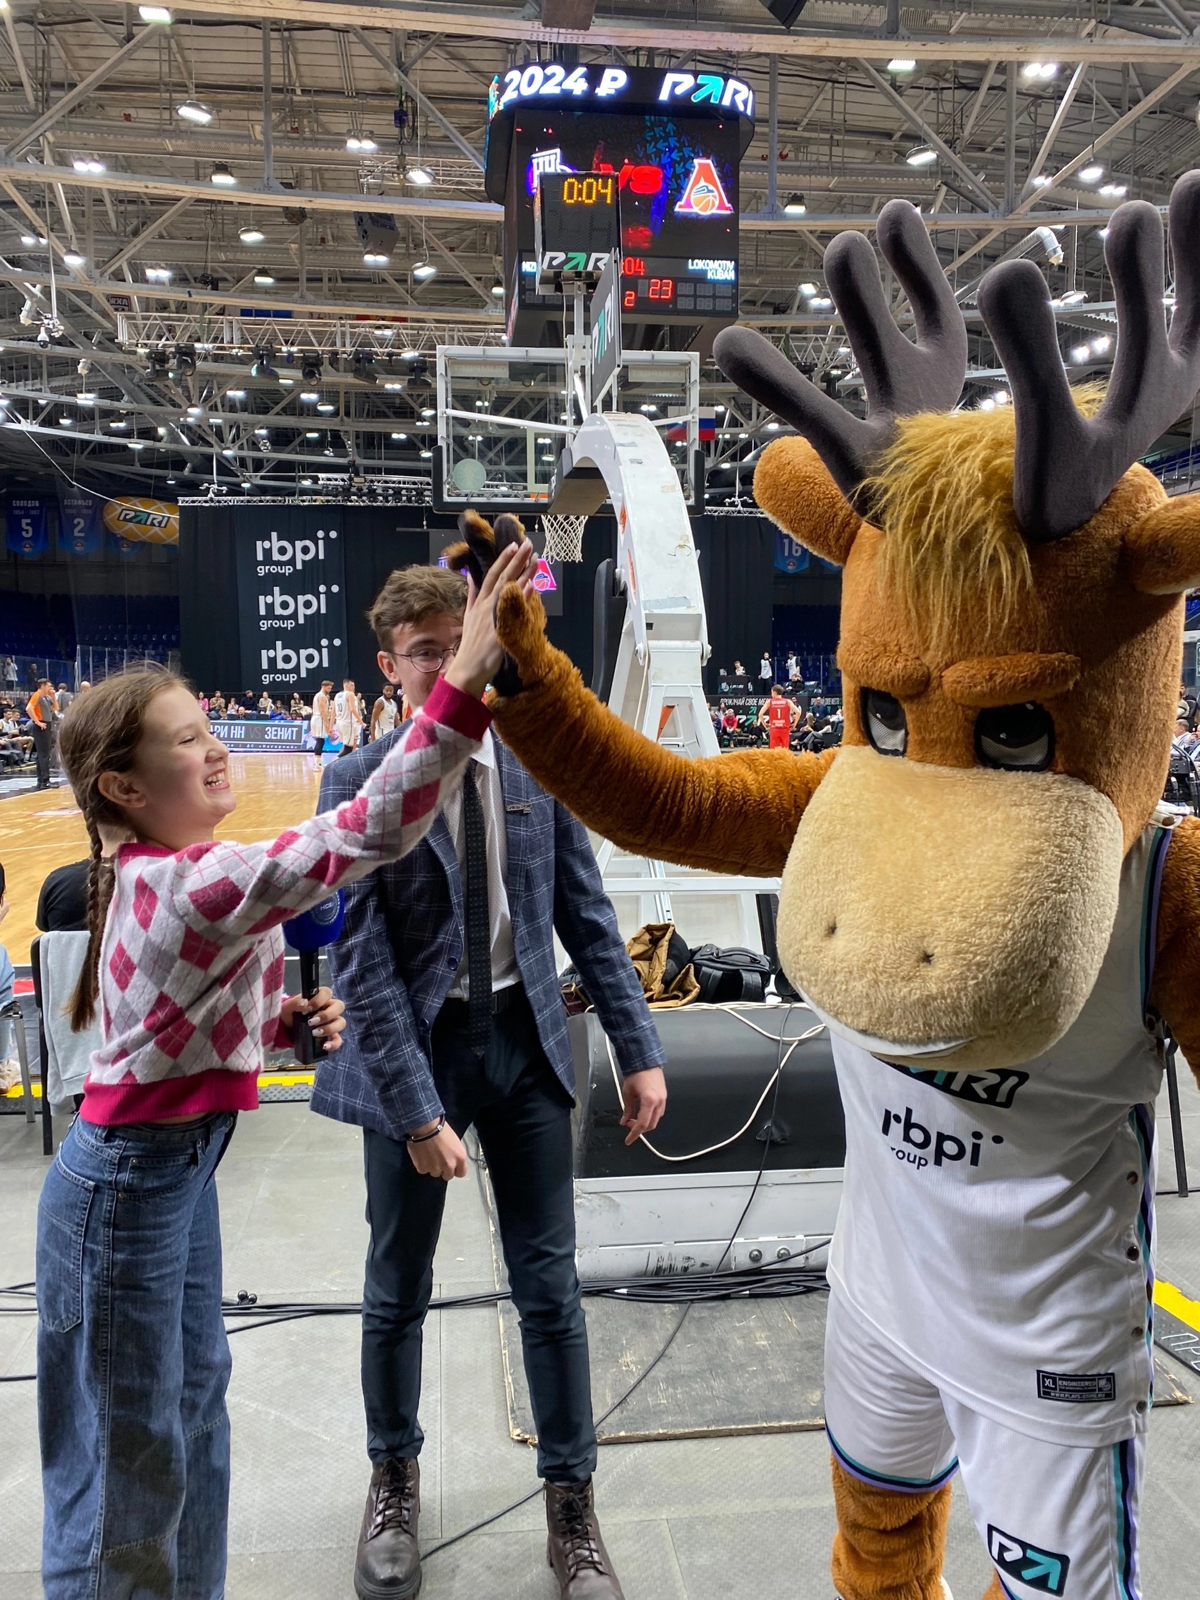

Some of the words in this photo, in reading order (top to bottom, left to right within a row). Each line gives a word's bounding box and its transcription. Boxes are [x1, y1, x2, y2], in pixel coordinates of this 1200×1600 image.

[501, 65, 588, 103] 2024
[563, 178, 612, 204] 0:04
[542, 251, 611, 271] PAR
[688, 259, 735, 270] LOKOMOTIV
[707, 269, 735, 281] KUBAN
[648, 279, 673, 299] 23
[21, 518, 33, 538] 5
[73, 517, 85, 537] 2
[119, 510, 168, 527] PARI
[256, 529, 337, 570] rbpi
[783, 538, 802, 557] 16
[257, 565, 293, 576] group
[258, 584, 339, 624] rbpi
[259, 619, 295, 631] group
[261, 638, 341, 678] rbpi
[261, 673, 297, 684] group
[230, 726, 245, 738] НН
[264, 727, 298, 740] ЗЕНИТ
[881, 1107, 1004, 1168] rbpi
[890, 1147, 928, 1170] oup
[1044, 1378, 1055, 1388] XL
